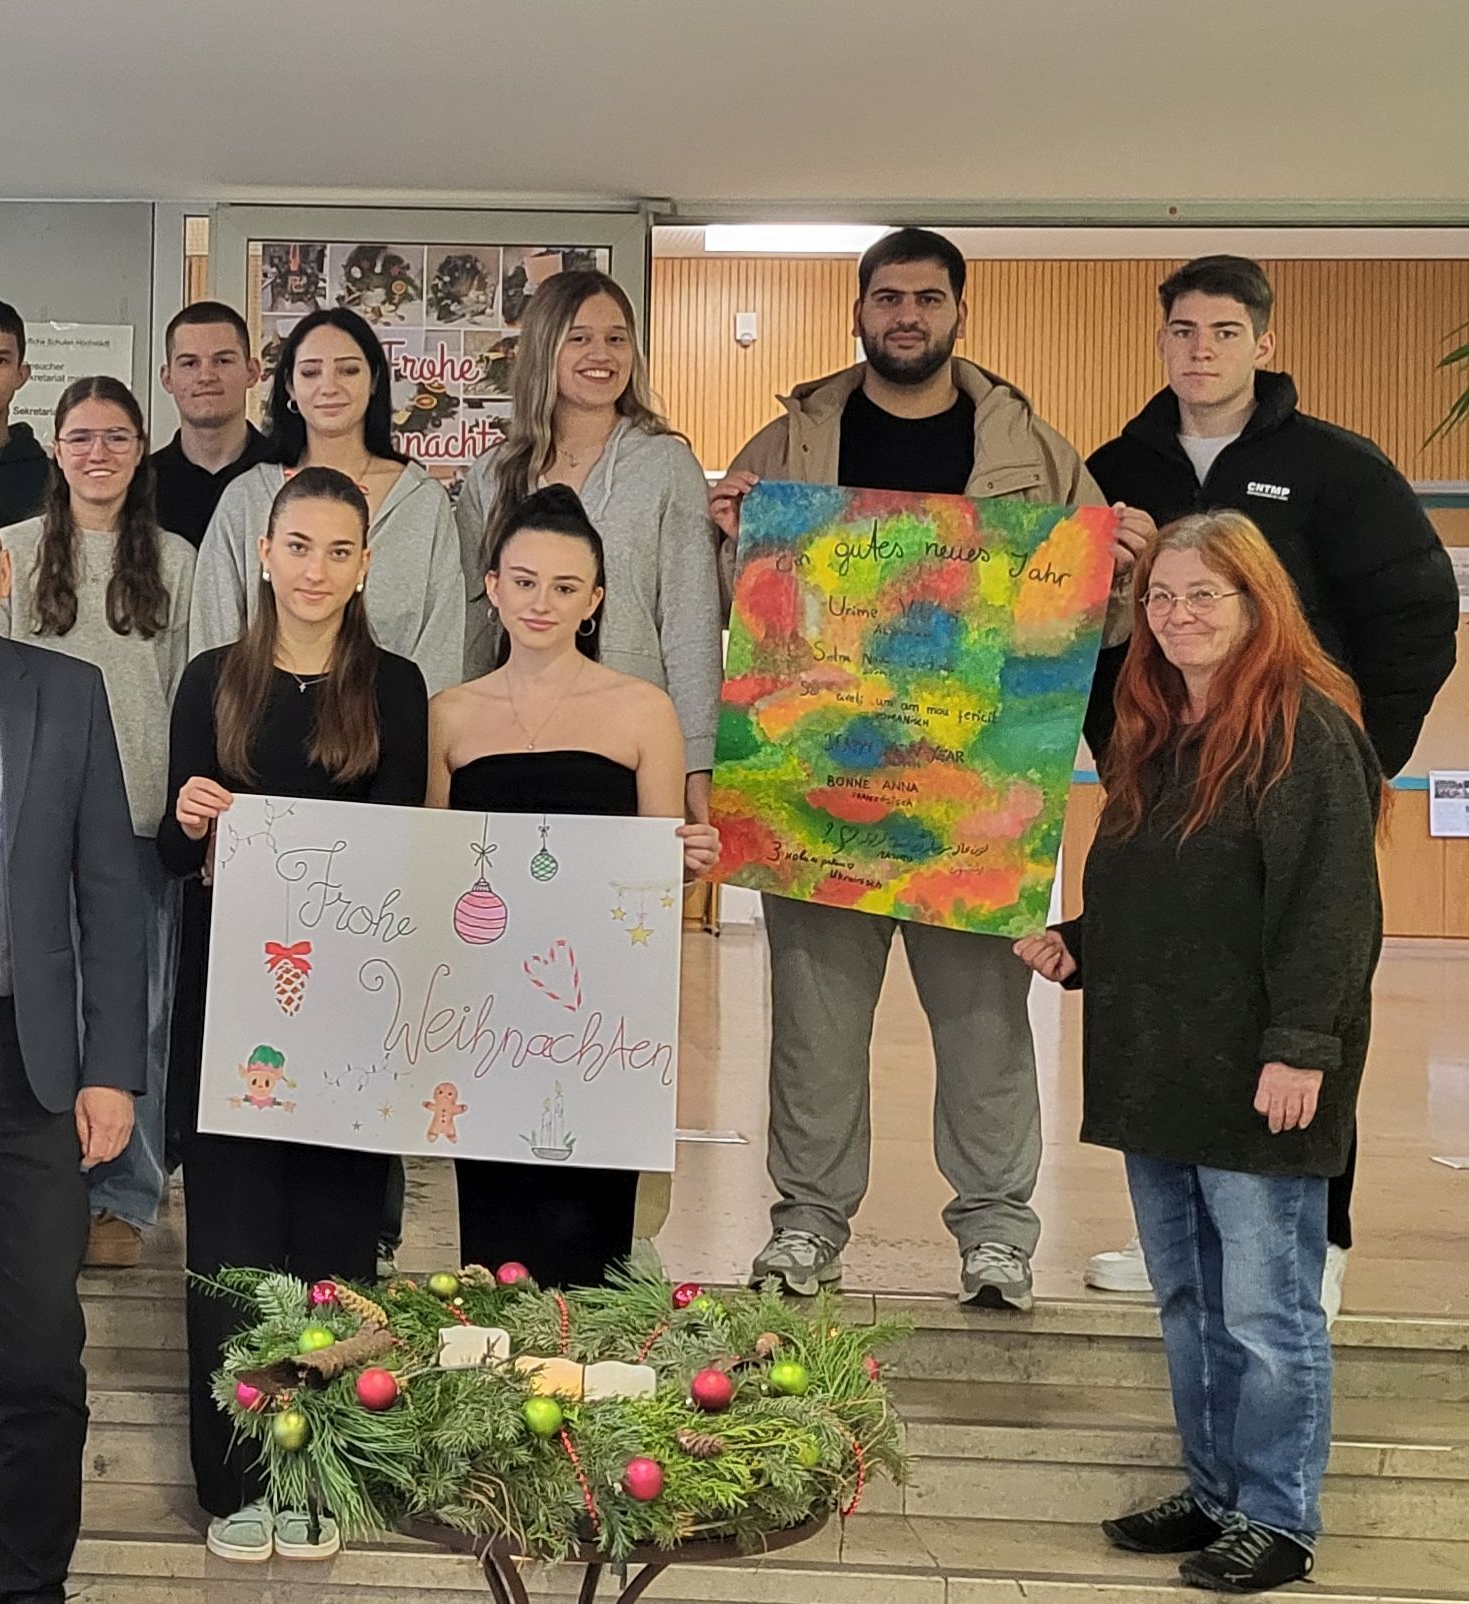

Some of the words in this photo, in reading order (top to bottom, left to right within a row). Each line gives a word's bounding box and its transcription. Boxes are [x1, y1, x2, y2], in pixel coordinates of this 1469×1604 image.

[381, 341, 480, 381] Frohe
[1247, 481, 1290, 496] CNTMP
[834, 519, 905, 577] gutes
[925, 540, 991, 564] neues
[1008, 550, 1071, 588] Jahr
[828, 595, 878, 618] Urime
[929, 744, 965, 764] YEAR
[827, 775, 870, 789] BONNE
[882, 779, 919, 793] ANNA
[276, 841, 418, 943] Frohe
[359, 959, 673, 1086] Weihnachten
